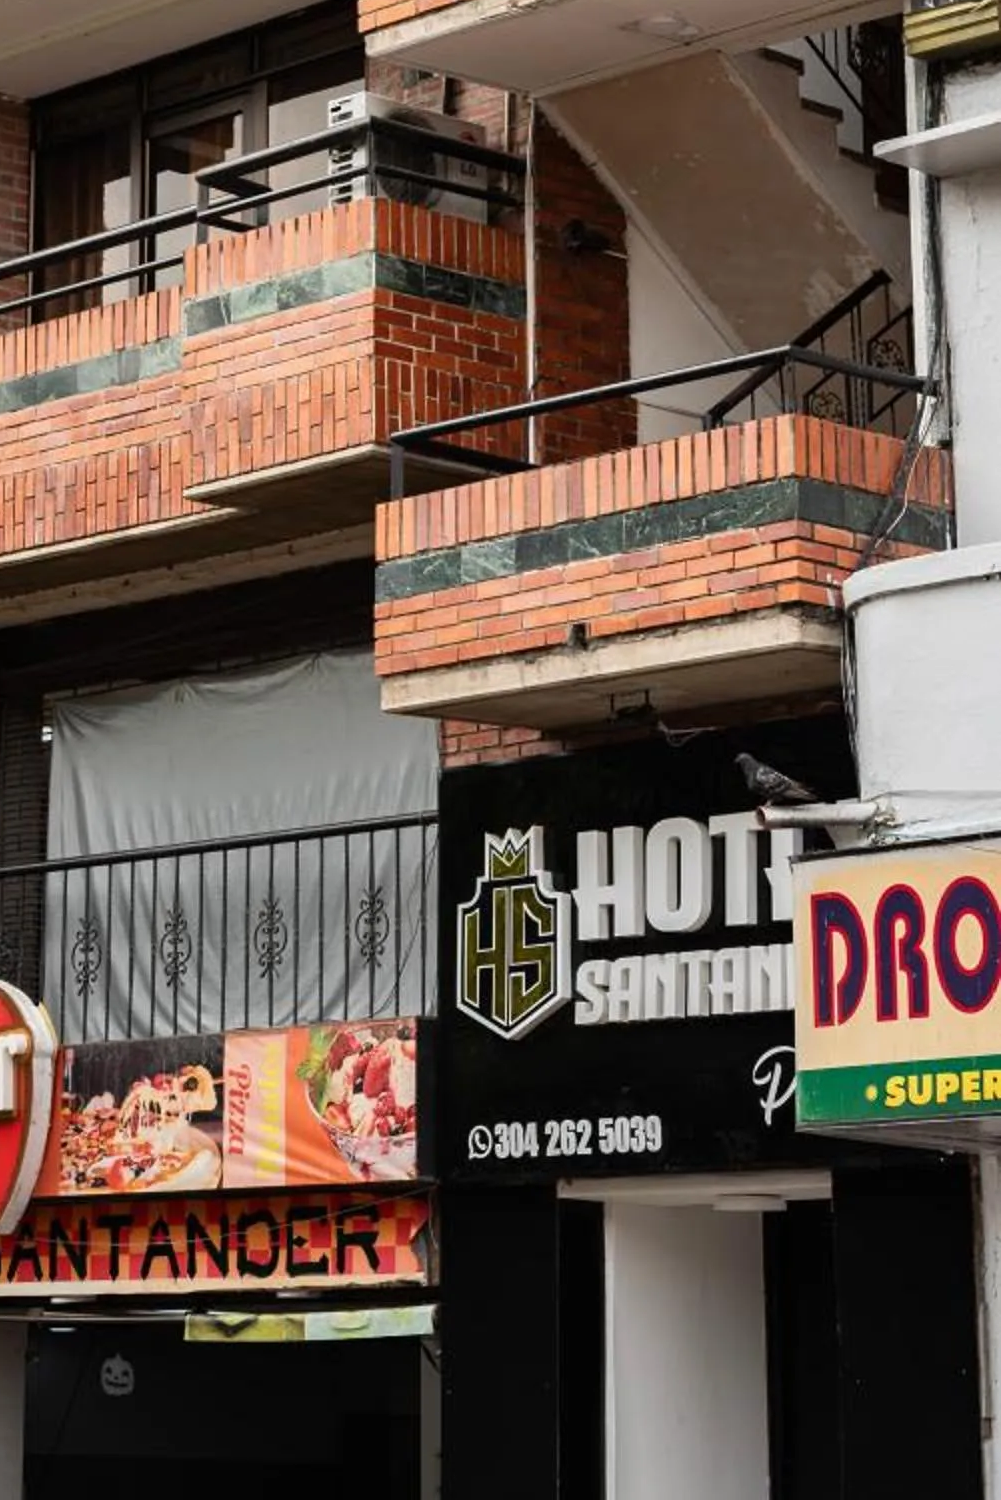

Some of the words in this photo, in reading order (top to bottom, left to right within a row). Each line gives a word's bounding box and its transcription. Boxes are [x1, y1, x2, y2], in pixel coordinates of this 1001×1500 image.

[574, 943, 796, 1025] SANTAN
[810, 875, 1001, 1029] DRO
[228, 1062, 253, 1156] Pizza
[494, 1122, 540, 1160] 304
[545, 1119, 593, 1157] 262
[599, 1114, 663, 1154] 5039
